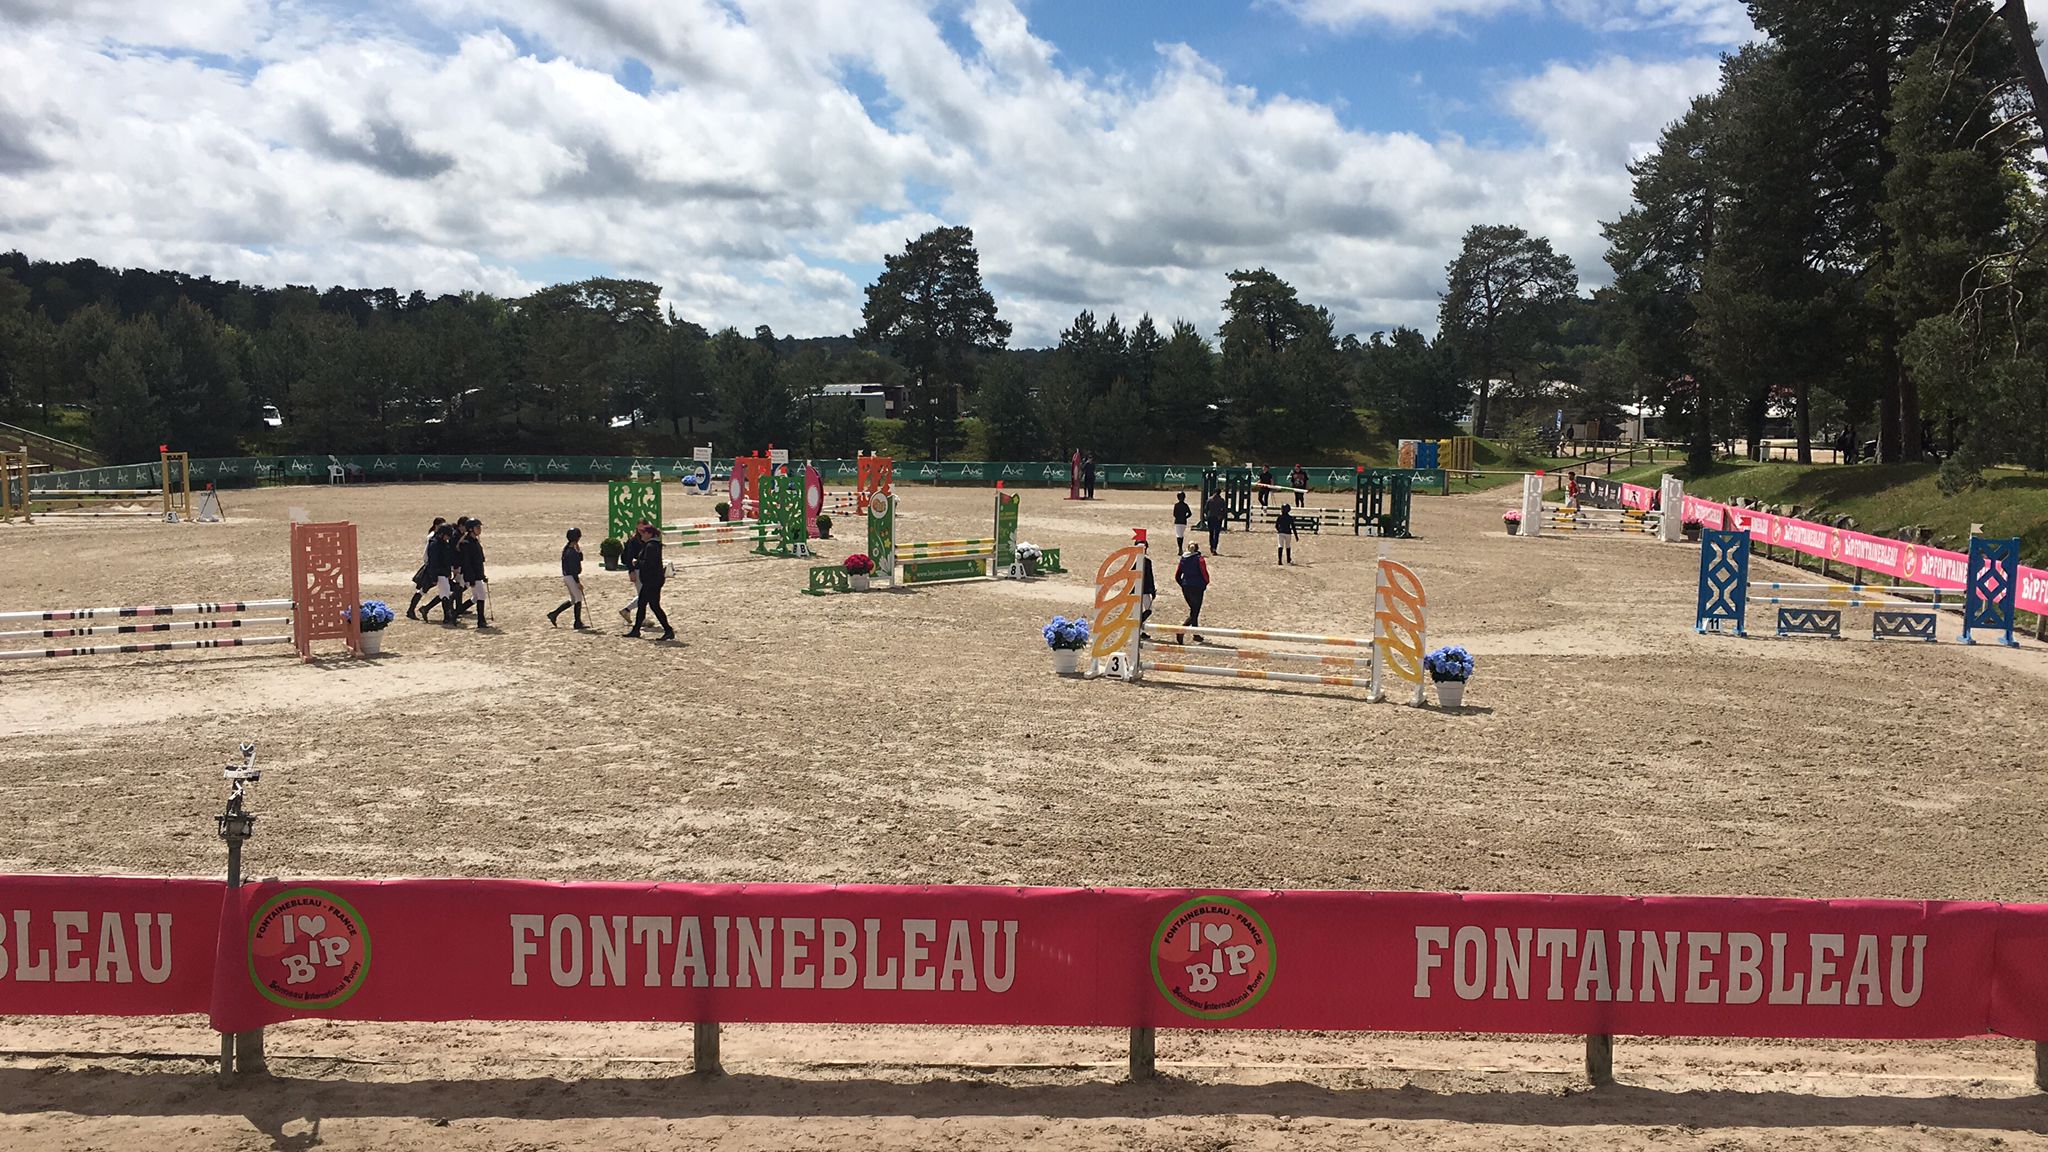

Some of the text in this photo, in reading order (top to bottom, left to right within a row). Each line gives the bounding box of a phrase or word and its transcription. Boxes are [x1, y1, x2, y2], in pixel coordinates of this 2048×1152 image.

[373, 457, 398, 470] AMC
[416, 457, 441, 470] AMC
[460, 457, 484, 470] AMC
[503, 457, 528, 470] AMC
[546, 457, 571, 471] AMC
[589, 458, 613, 471] AMC
[920, 464, 943, 475] AMC
[961, 464, 984, 475] AMC
[1001, 464, 1024, 475] AMC
[1042, 465, 1065, 477] AMC
[1123, 467, 1146, 478] AMC
[1164, 468, 1187, 479] AMC
[1327, 470, 1350, 481] AMC
[1410, 471, 1435, 482] AMC
[167, 513, 173, 521] 5
[1010, 565, 1017, 575] 8
[1709, 619, 1719, 630] 11
[1111, 656, 1119, 671] 3
[256, 898, 322, 939] FONTAINEBLEAU
[327, 905, 358, 937] FRANCE
[282, 914, 296, 944] I
[1164, 906, 1231, 944] FONTAINEBLEAU
[1236, 914, 1263, 945] FRANCE
[1189, 921, 1201, 952] I
[0, 909, 173, 984] LEAU
[509, 912, 1019, 993] FONTAINEBLEAU
[1413, 925, 1928, 1007] FONTAINEBLEAU
[1203, 989, 1250, 1011] International
